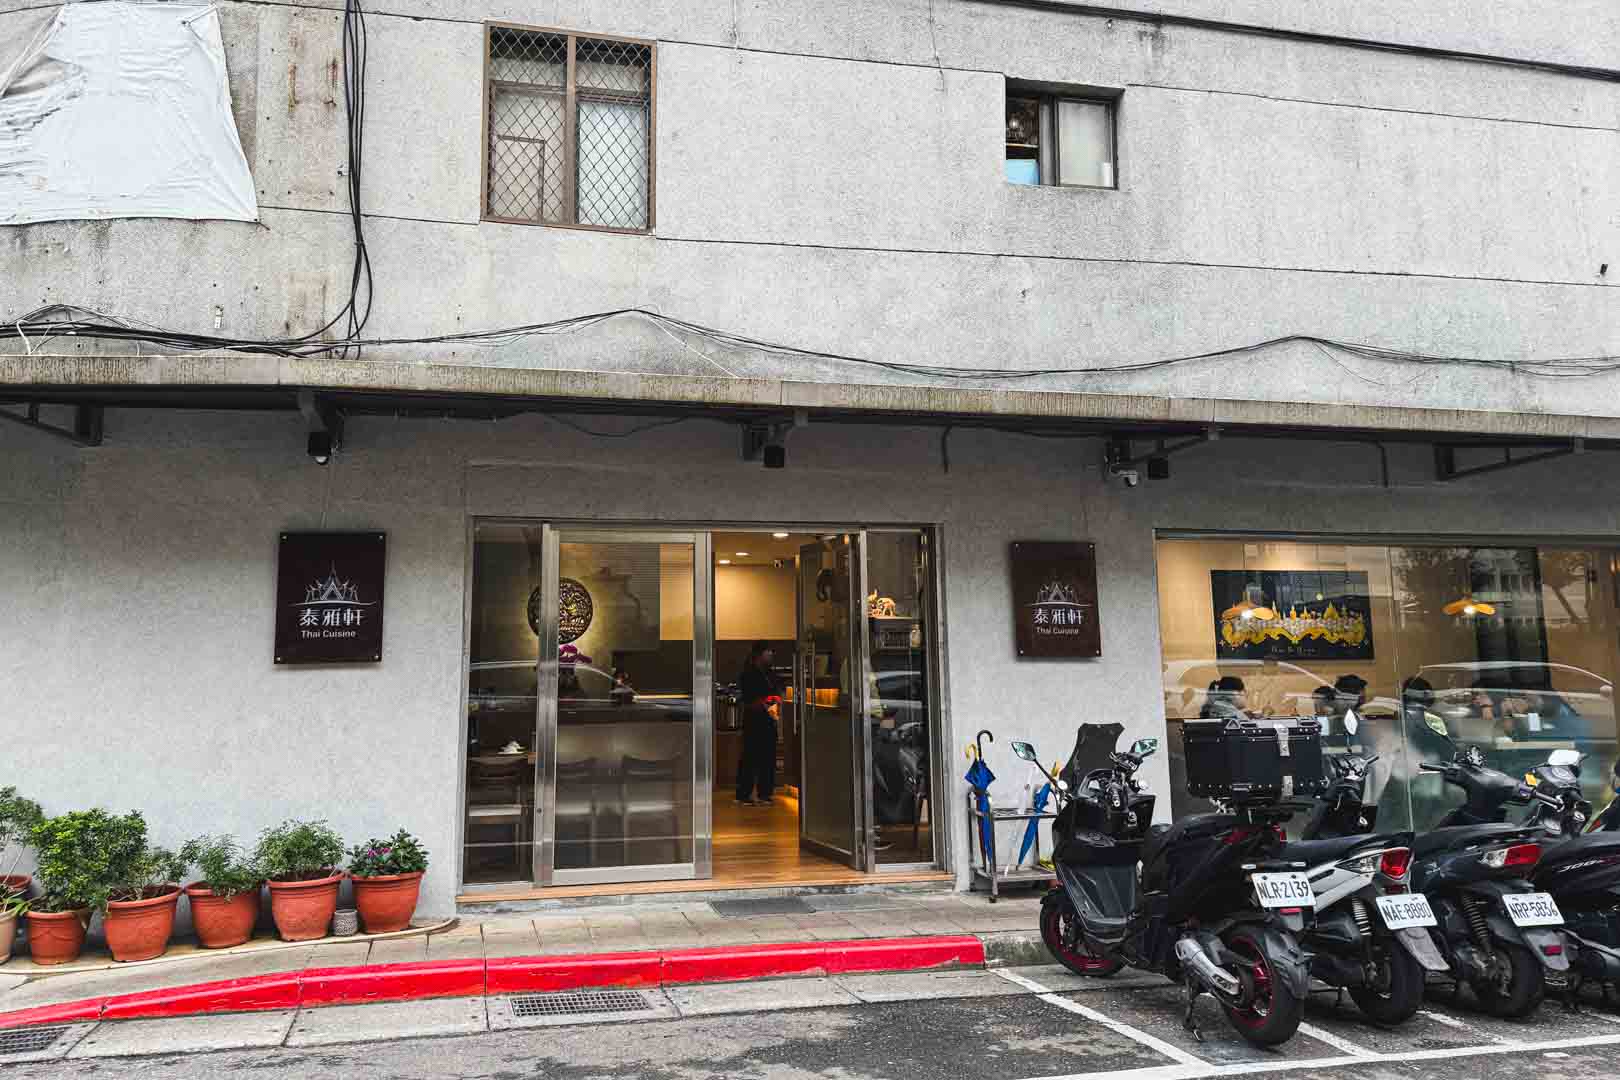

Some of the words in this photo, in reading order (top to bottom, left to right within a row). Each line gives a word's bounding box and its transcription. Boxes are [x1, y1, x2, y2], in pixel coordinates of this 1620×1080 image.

[301, 630, 320, 639] Thai
[322, 629, 356, 638] Cuisine
[1036, 626, 1051, 634] Thai
[1256, 881, 1309, 899] NLR-2139
[1509, 901, 1559, 919] NRP-5836
